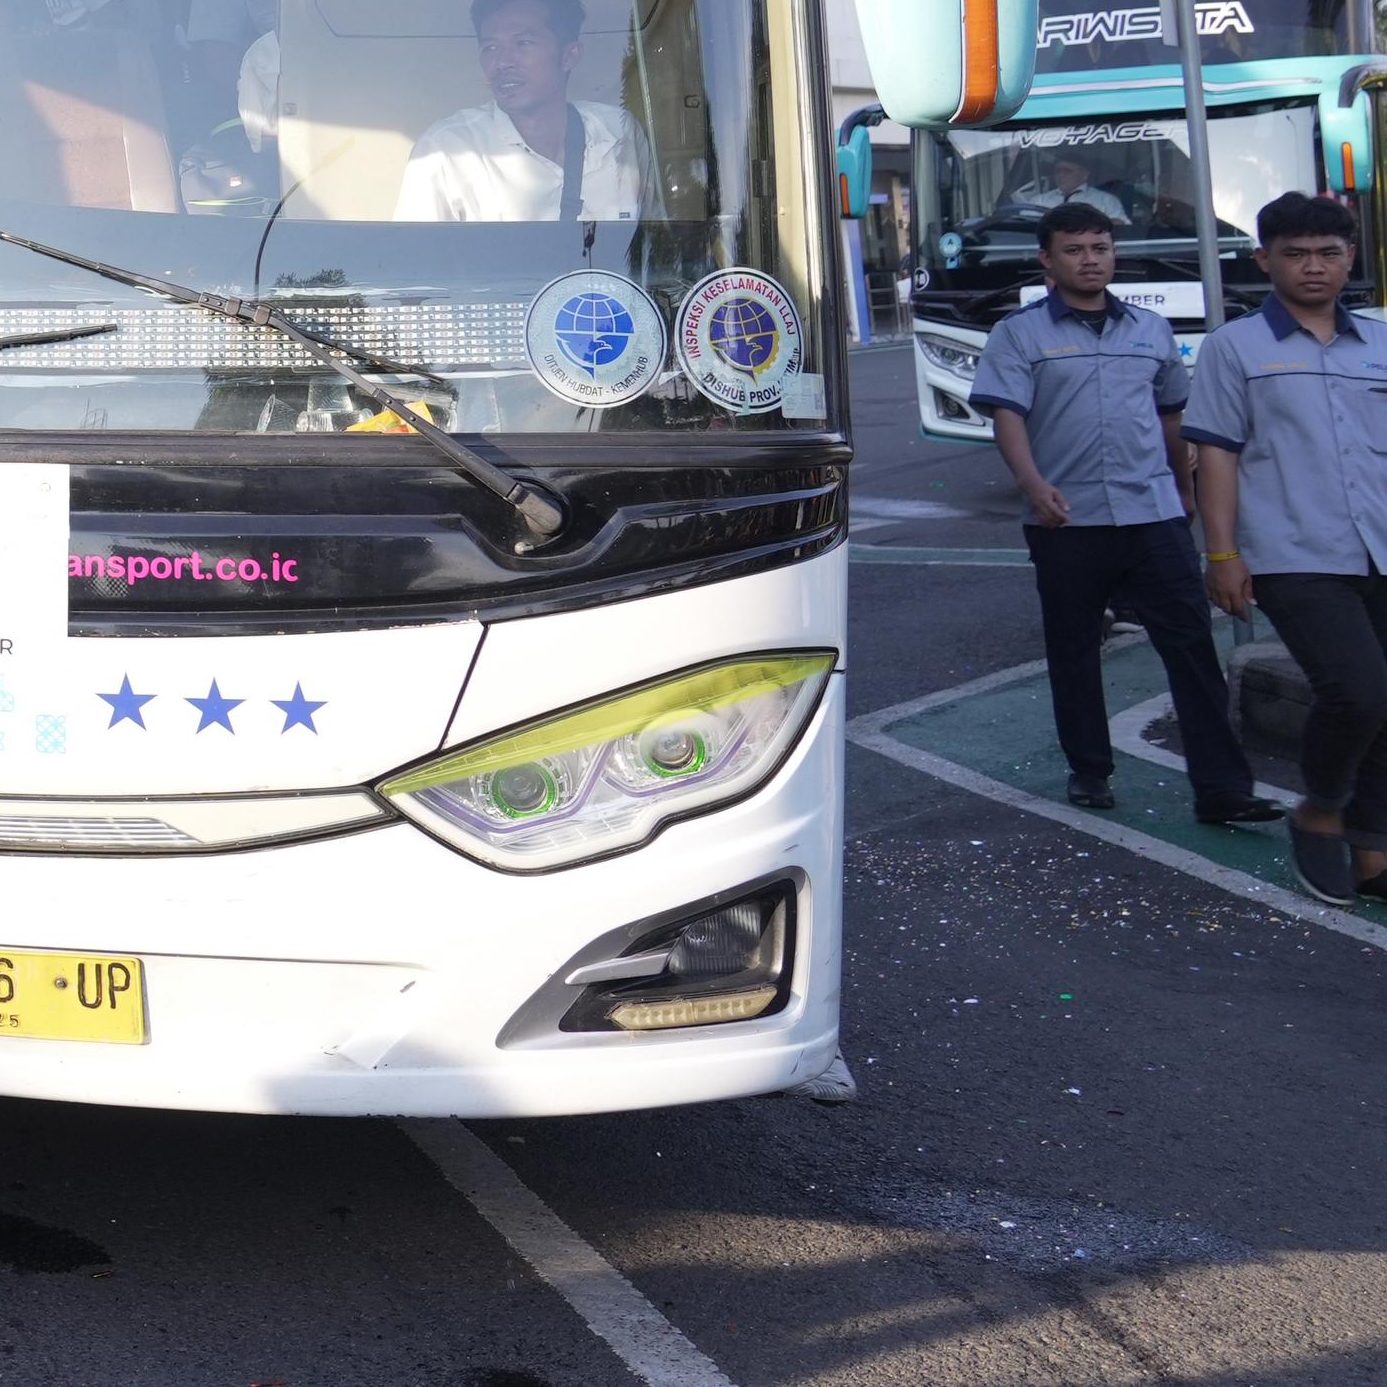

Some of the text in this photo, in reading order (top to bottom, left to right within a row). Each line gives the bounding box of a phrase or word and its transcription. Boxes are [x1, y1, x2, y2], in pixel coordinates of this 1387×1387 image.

[685, 277, 796, 359] INSPEKSI KESELAMATAN LLAJ
[544, 354, 568, 383] DITJEN
[568, 378, 604, 397] HUBDAT
[611, 356, 649, 394] KEMENHUB
[703, 372, 746, 402] DISHUB
[77, 962, 131, 1010] UP
